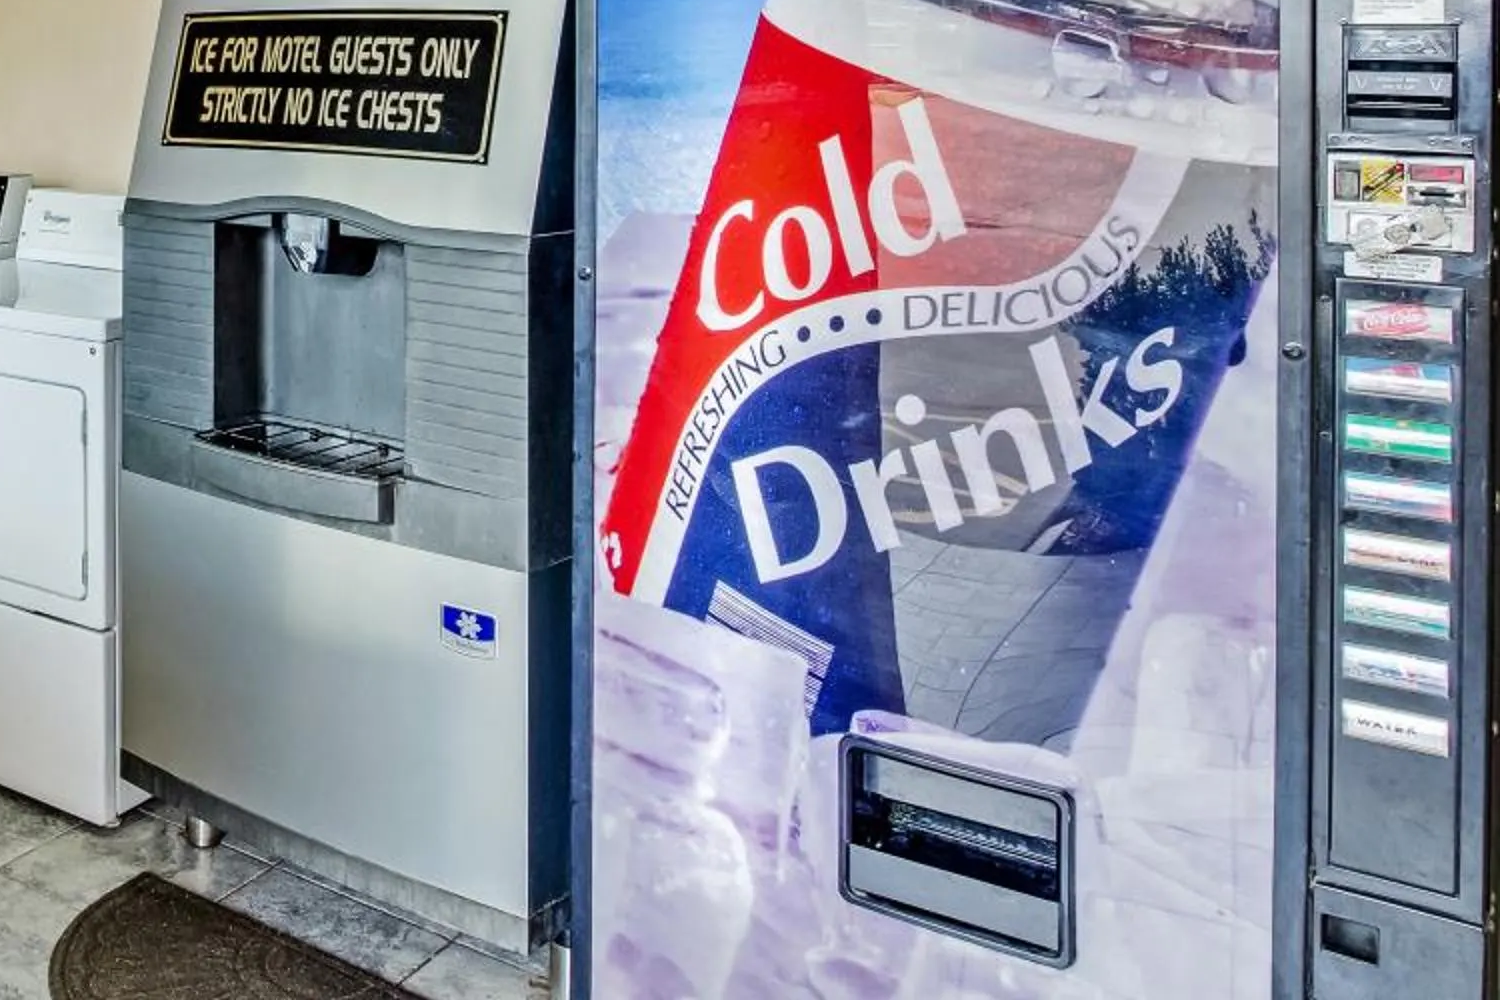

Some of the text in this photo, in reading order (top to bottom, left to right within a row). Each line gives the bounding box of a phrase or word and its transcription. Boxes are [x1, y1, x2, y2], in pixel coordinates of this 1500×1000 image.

[190, 36, 480, 79] ICE FOR MOTEL GUESTS ONLY
[199, 86, 445, 133] STRICTLY NO ICE CHESTS
[696, 96, 967, 333] Cold
[664, 215, 1140, 521] REFRESHING DELICIOUS
[731, 326, 1183, 584] Drinks
